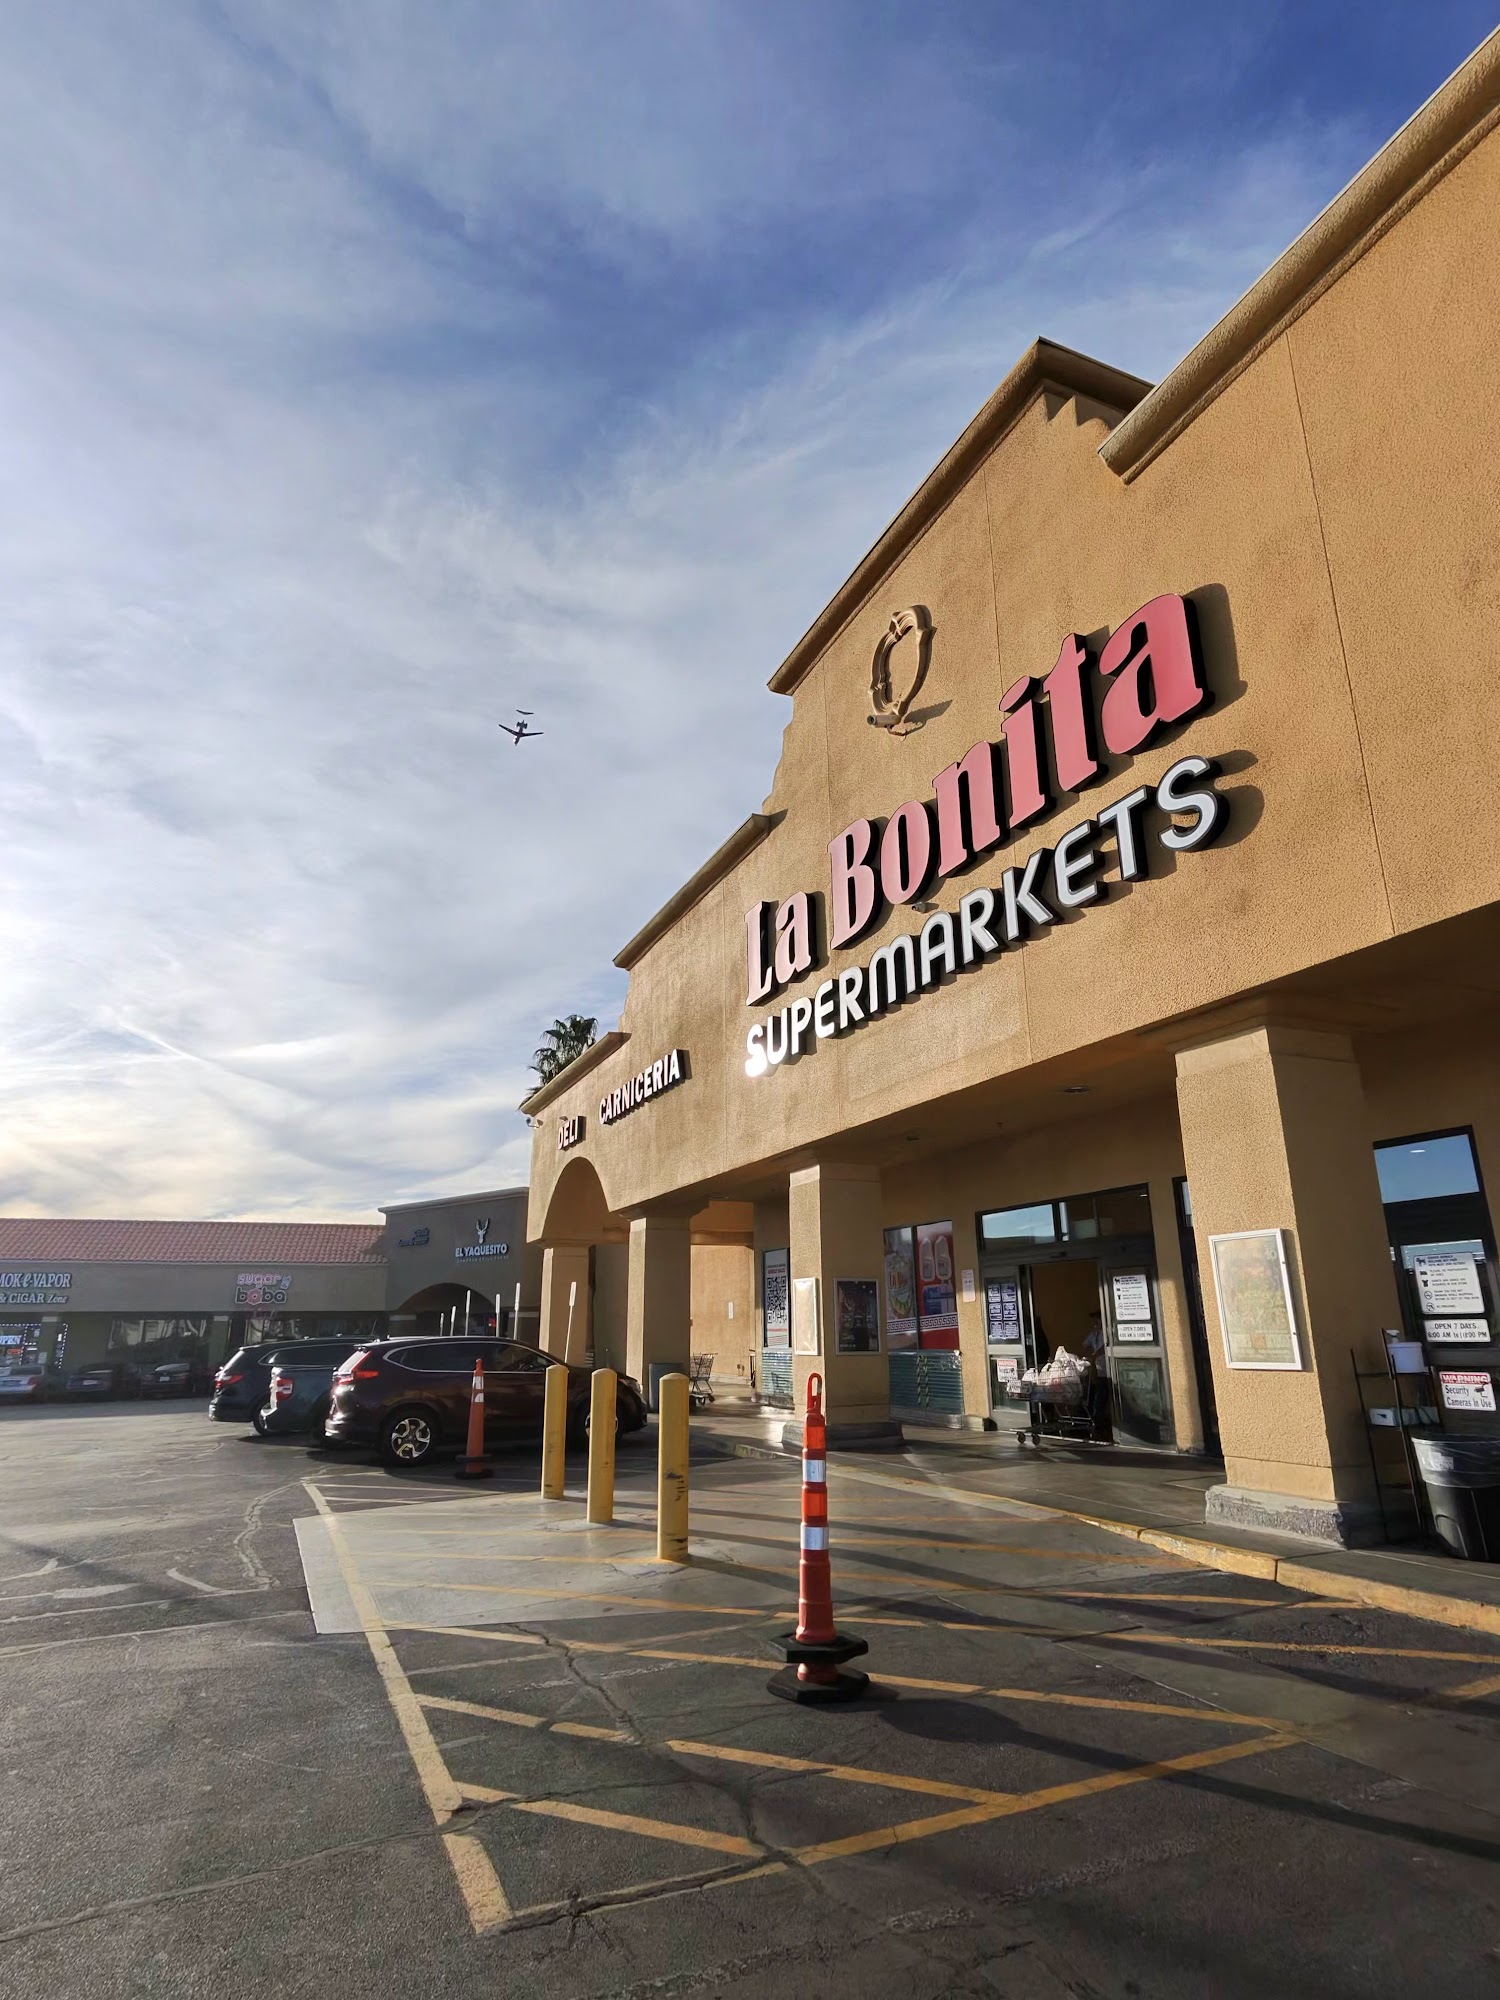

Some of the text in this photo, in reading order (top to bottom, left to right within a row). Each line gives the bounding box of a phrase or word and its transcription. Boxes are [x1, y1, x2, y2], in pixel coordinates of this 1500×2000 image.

[744, 593, 1206, 1006] La Bonita
[744, 755, 1221, 1077] SUPERMARKETS
[599, 1048, 681, 1125] CARNICERIA
[558, 1115, 580, 1150] DELI
[455, 1243, 508, 1257] EL YAQUESITO
[238, 1274, 282, 1288] sugar
[9, 1293, 45, 1303] CIGAR
[235, 1286, 287, 1305] boba
[1441, 1374, 1489, 1383] WARNING
[1445, 1385, 1470, 1395] Security
[1446, 1397, 1493, 1408] Cameras In Use
